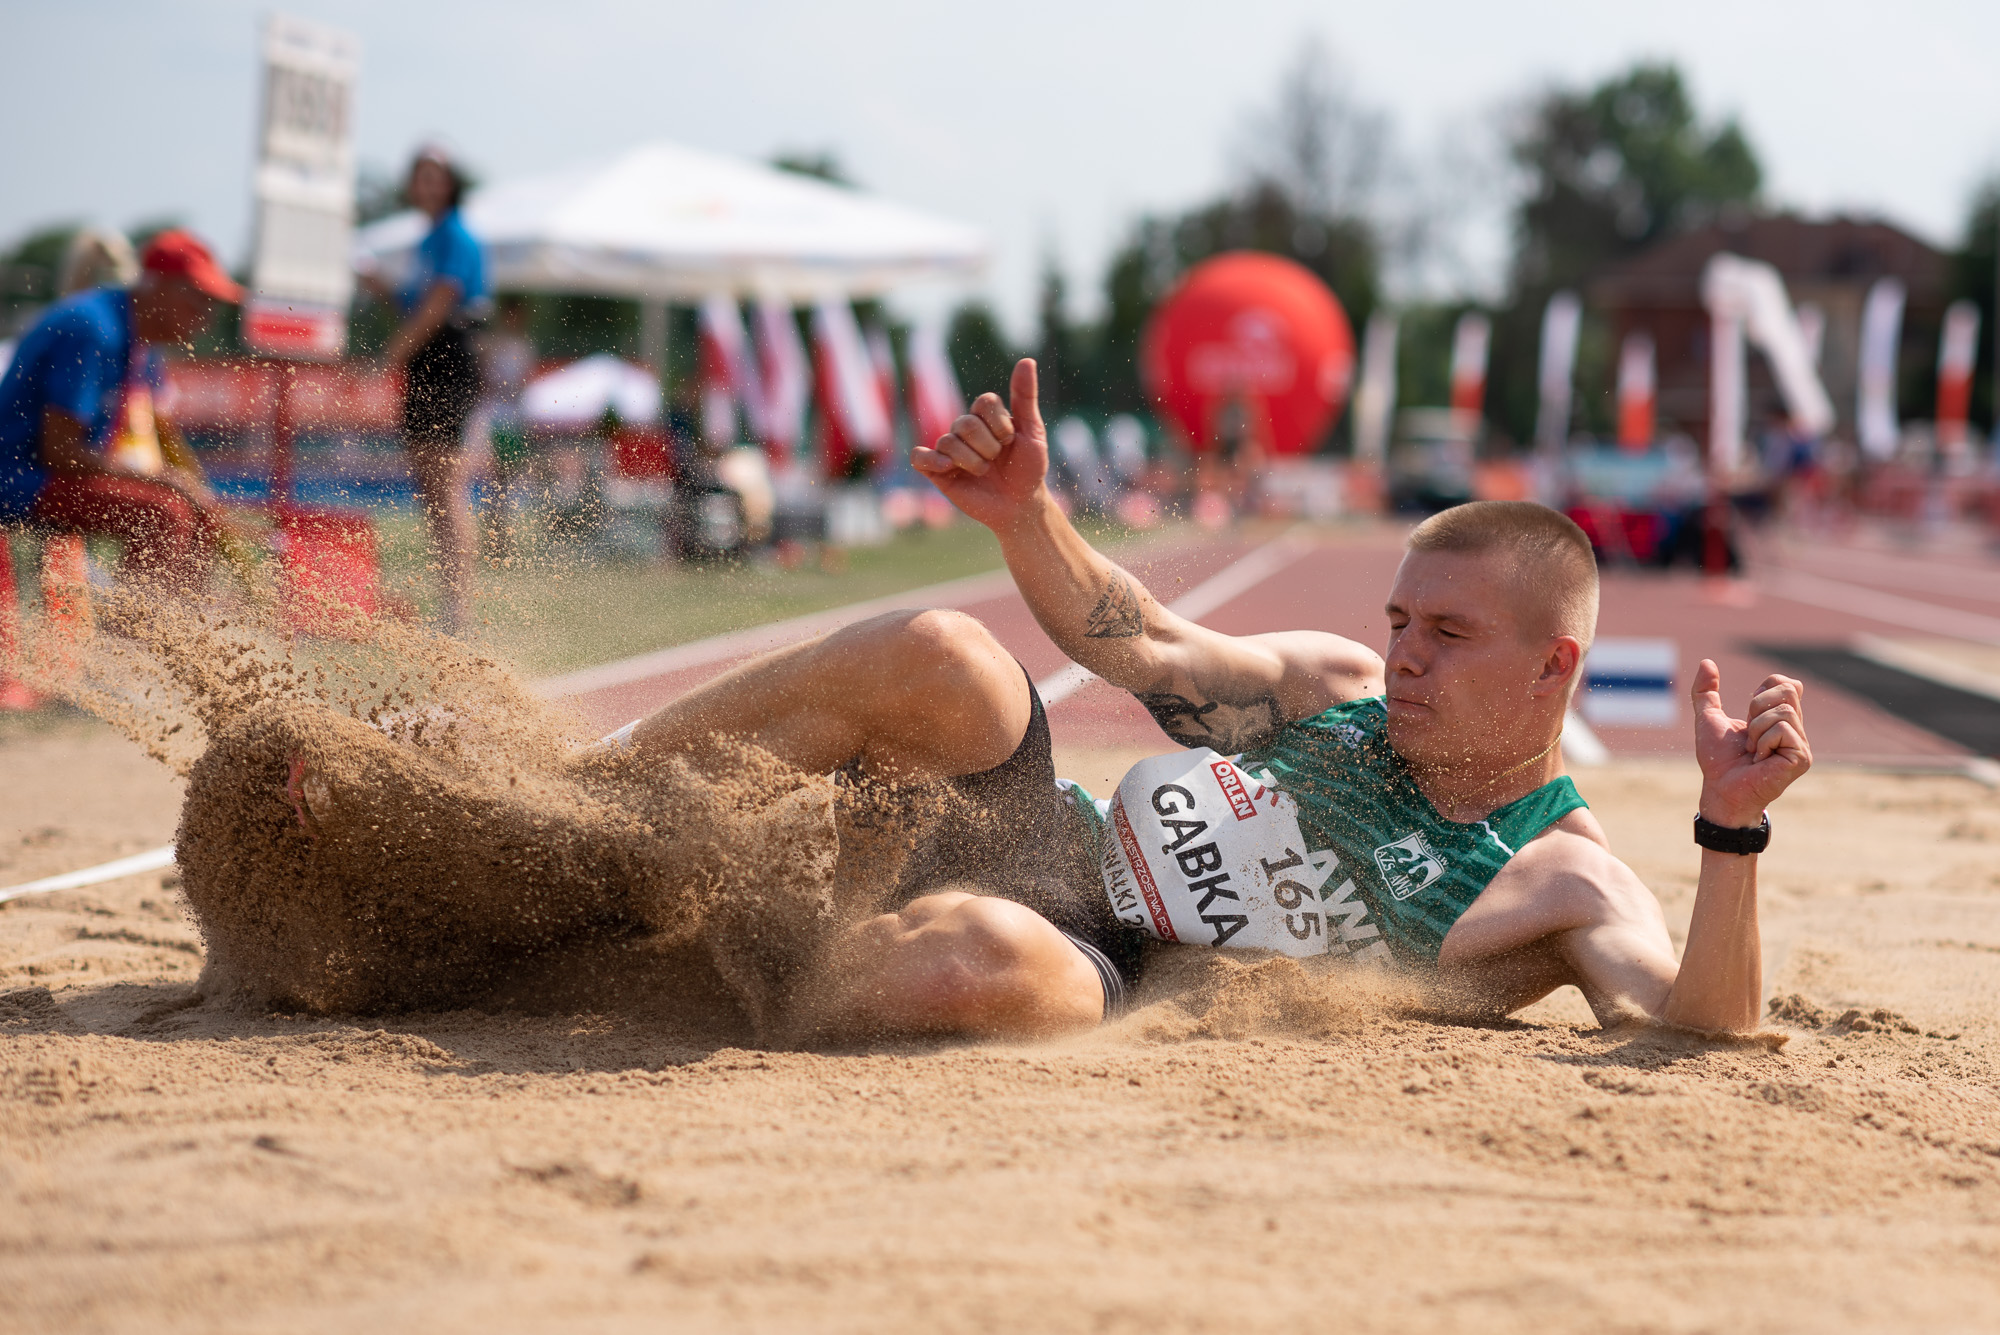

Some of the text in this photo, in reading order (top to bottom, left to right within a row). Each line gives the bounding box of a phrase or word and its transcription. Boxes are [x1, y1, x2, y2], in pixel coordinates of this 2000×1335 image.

[1215, 763, 1253, 817] ORLEN
[1151, 783, 1250, 948] GĄBKA
[1377, 851, 1413, 896] AZS AWF
[1259, 847, 1321, 941] 165
[1156, 916, 1175, 943] POL
